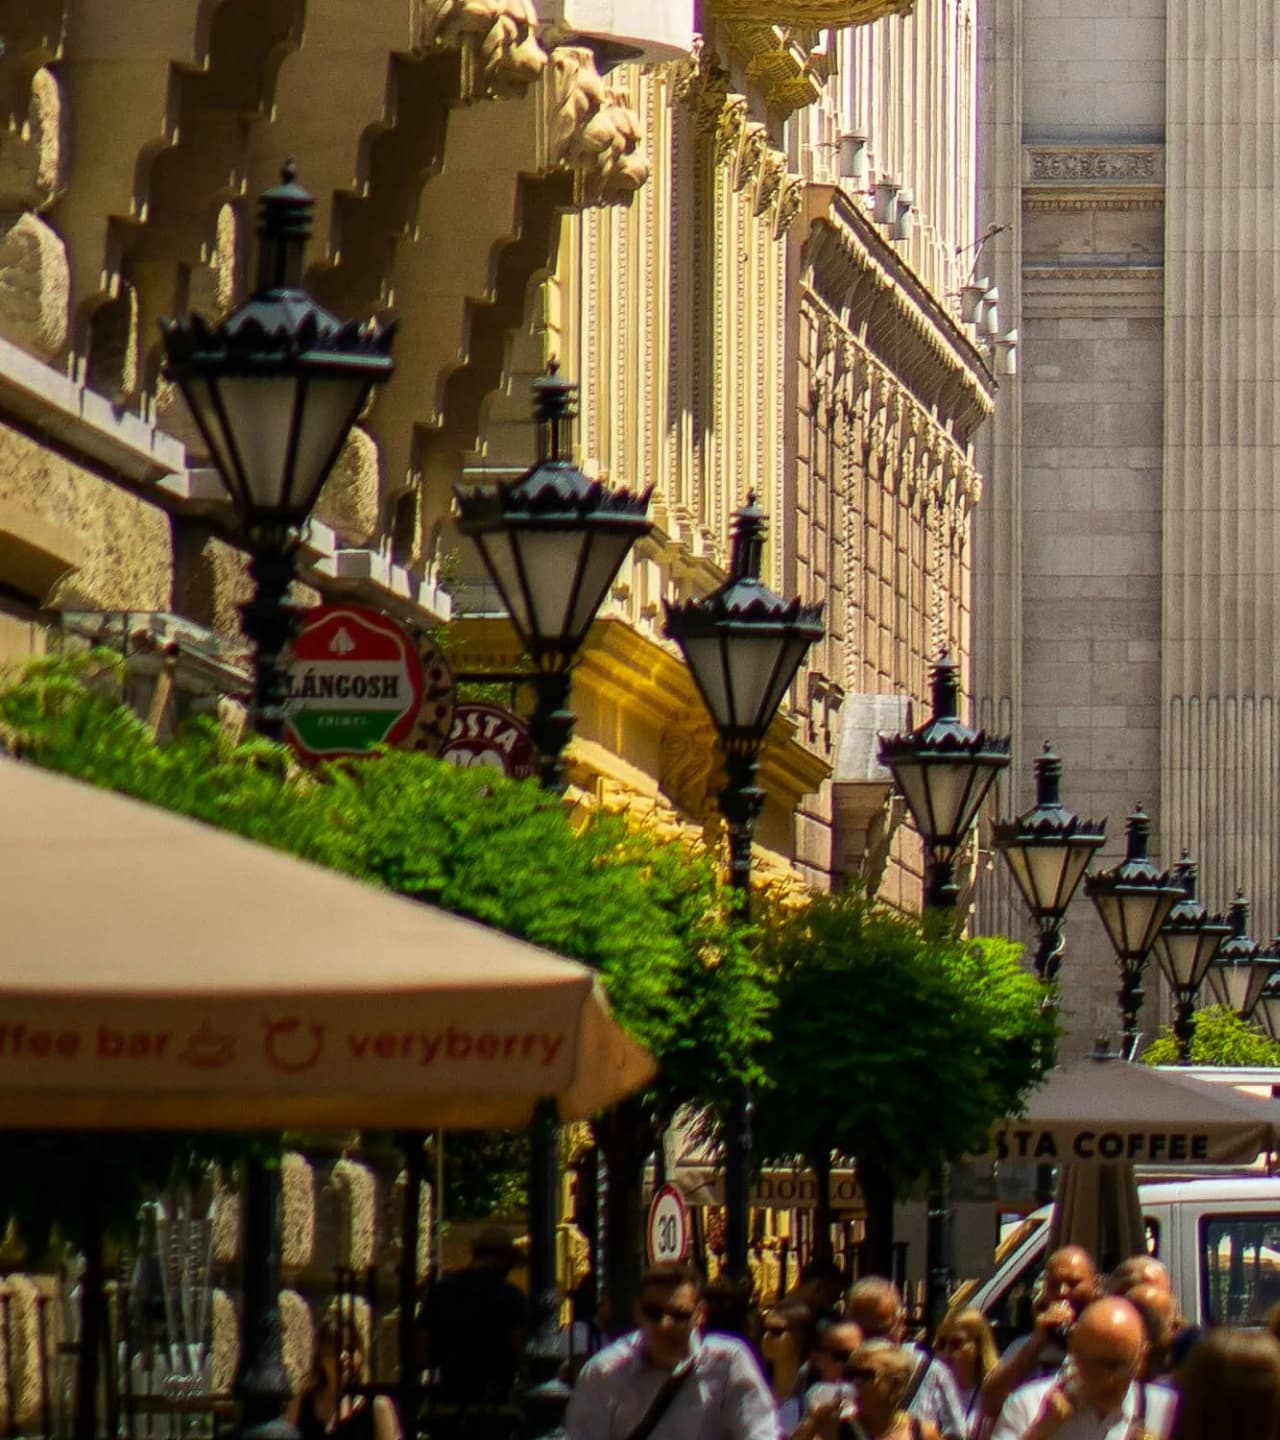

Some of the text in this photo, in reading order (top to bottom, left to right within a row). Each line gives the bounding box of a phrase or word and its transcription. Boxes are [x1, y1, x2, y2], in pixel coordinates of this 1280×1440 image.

[286, 667, 400, 698] LÁNGOSH
[96, 1022, 171, 1058] bar
[350, 1022, 565, 1068] veryberry
[1073, 1131, 1209, 1160] COFFEE
[658, 1213, 677, 1253] 30
